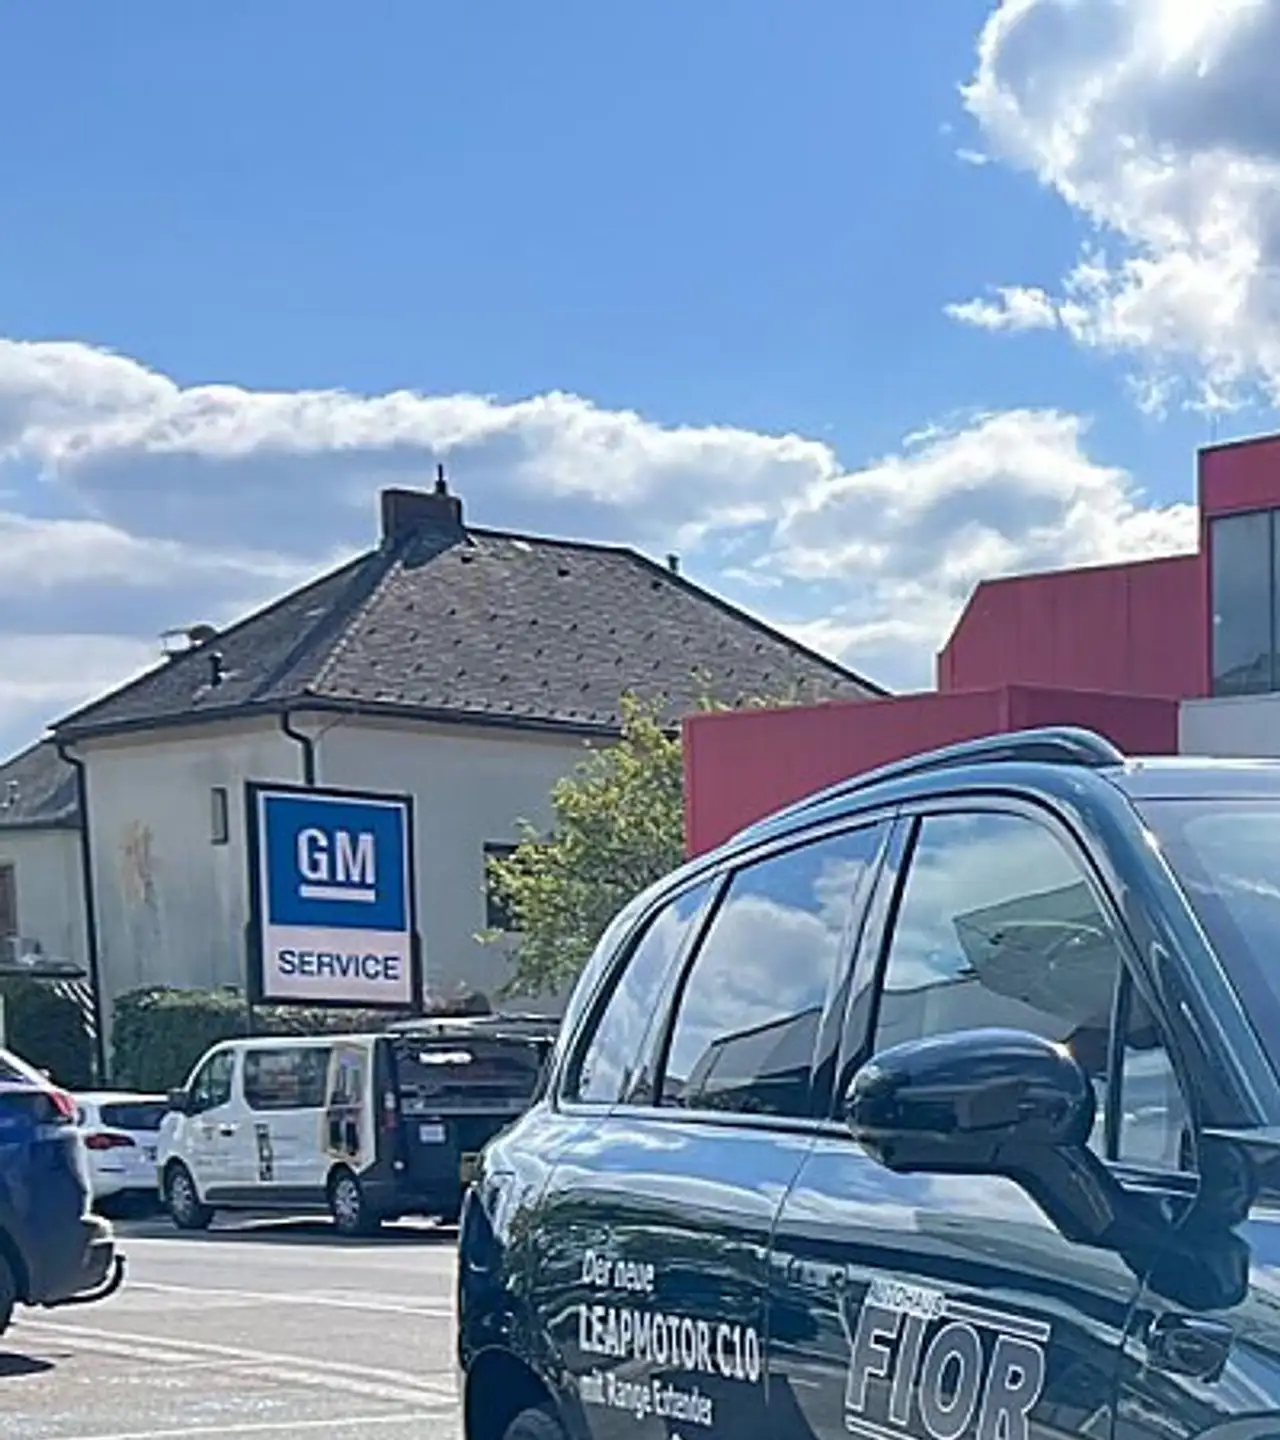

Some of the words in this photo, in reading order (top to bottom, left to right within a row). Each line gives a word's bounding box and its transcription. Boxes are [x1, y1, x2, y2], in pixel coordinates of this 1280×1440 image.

[297, 828, 376, 885] GM
[278, 950, 400, 980] SERVICE
[582, 1250, 612, 1286] Der
[614, 1260, 655, 1292] neue
[579, 1303, 716, 1374] LEAPMOTOR
[716, 1323, 760, 1383] C10
[606, 1371, 653, 1419] Range
[652, 1378, 713, 1426] Extender
